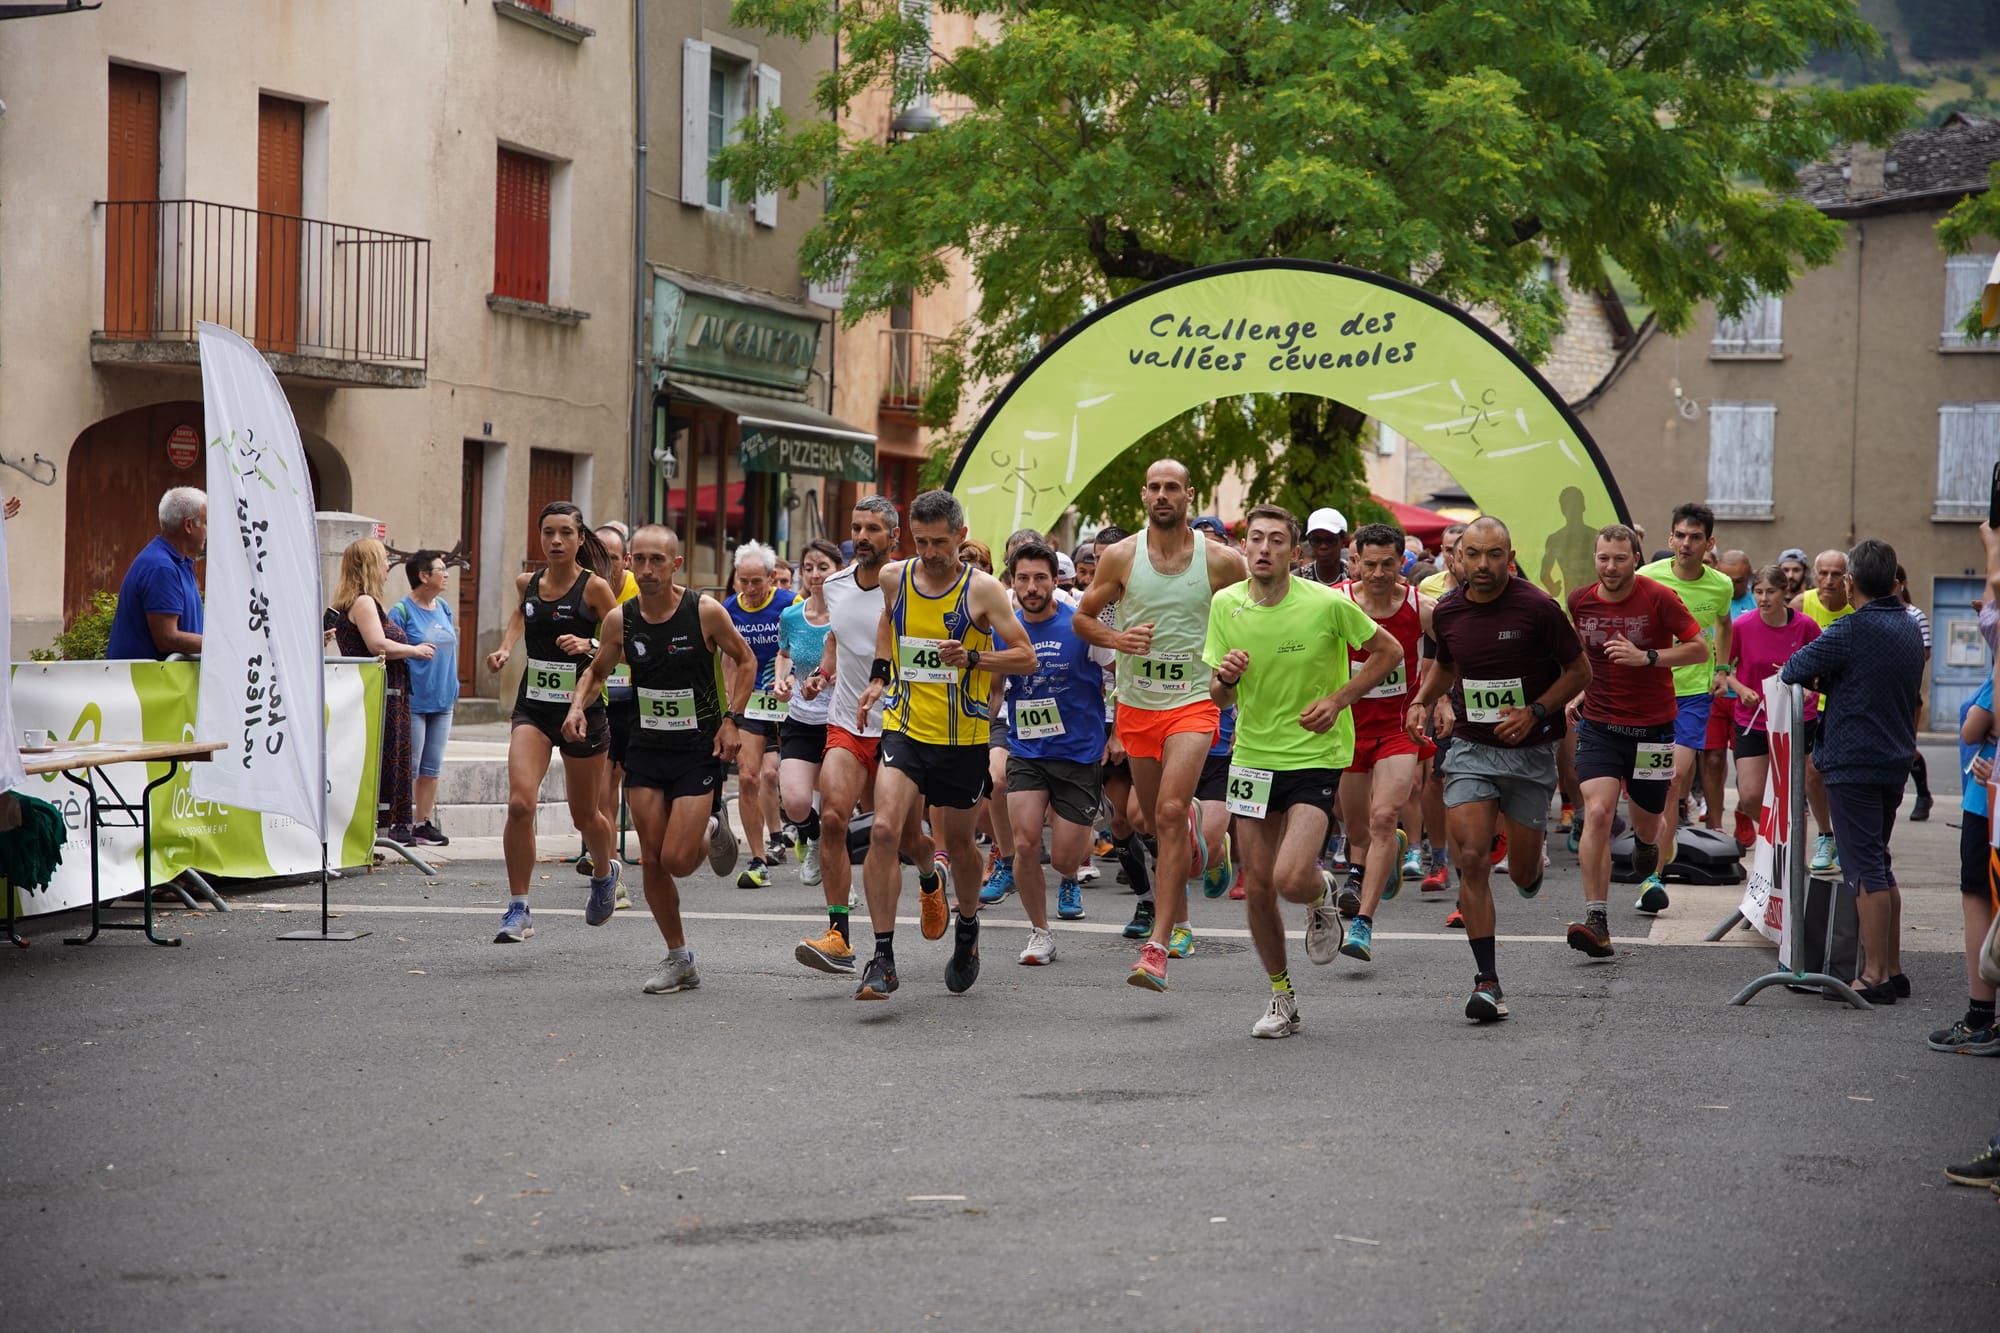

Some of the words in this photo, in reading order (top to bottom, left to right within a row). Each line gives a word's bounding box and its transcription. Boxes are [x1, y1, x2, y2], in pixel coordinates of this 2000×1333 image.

[1150, 313, 1318, 349] Challenge
[1339, 312, 1396, 337] des
[1129, 344, 1247, 371] vallées
[1268, 341, 1417, 371] cévenoles
[779, 438, 844, 472] PIZZERIA
[753, 633, 779, 645] NÎMO
[912, 650, 941, 669] 48
[1142, 660, 1184, 680] 115
[537, 671, 560, 689] 56
[652, 700, 679, 717] 55
[758, 697, 777, 710] 18
[1472, 690, 1515, 709] 104
[1020, 708, 1052, 726] 101
[1650, 753, 1673, 769] 35
[1230, 778, 1254, 800] 43
